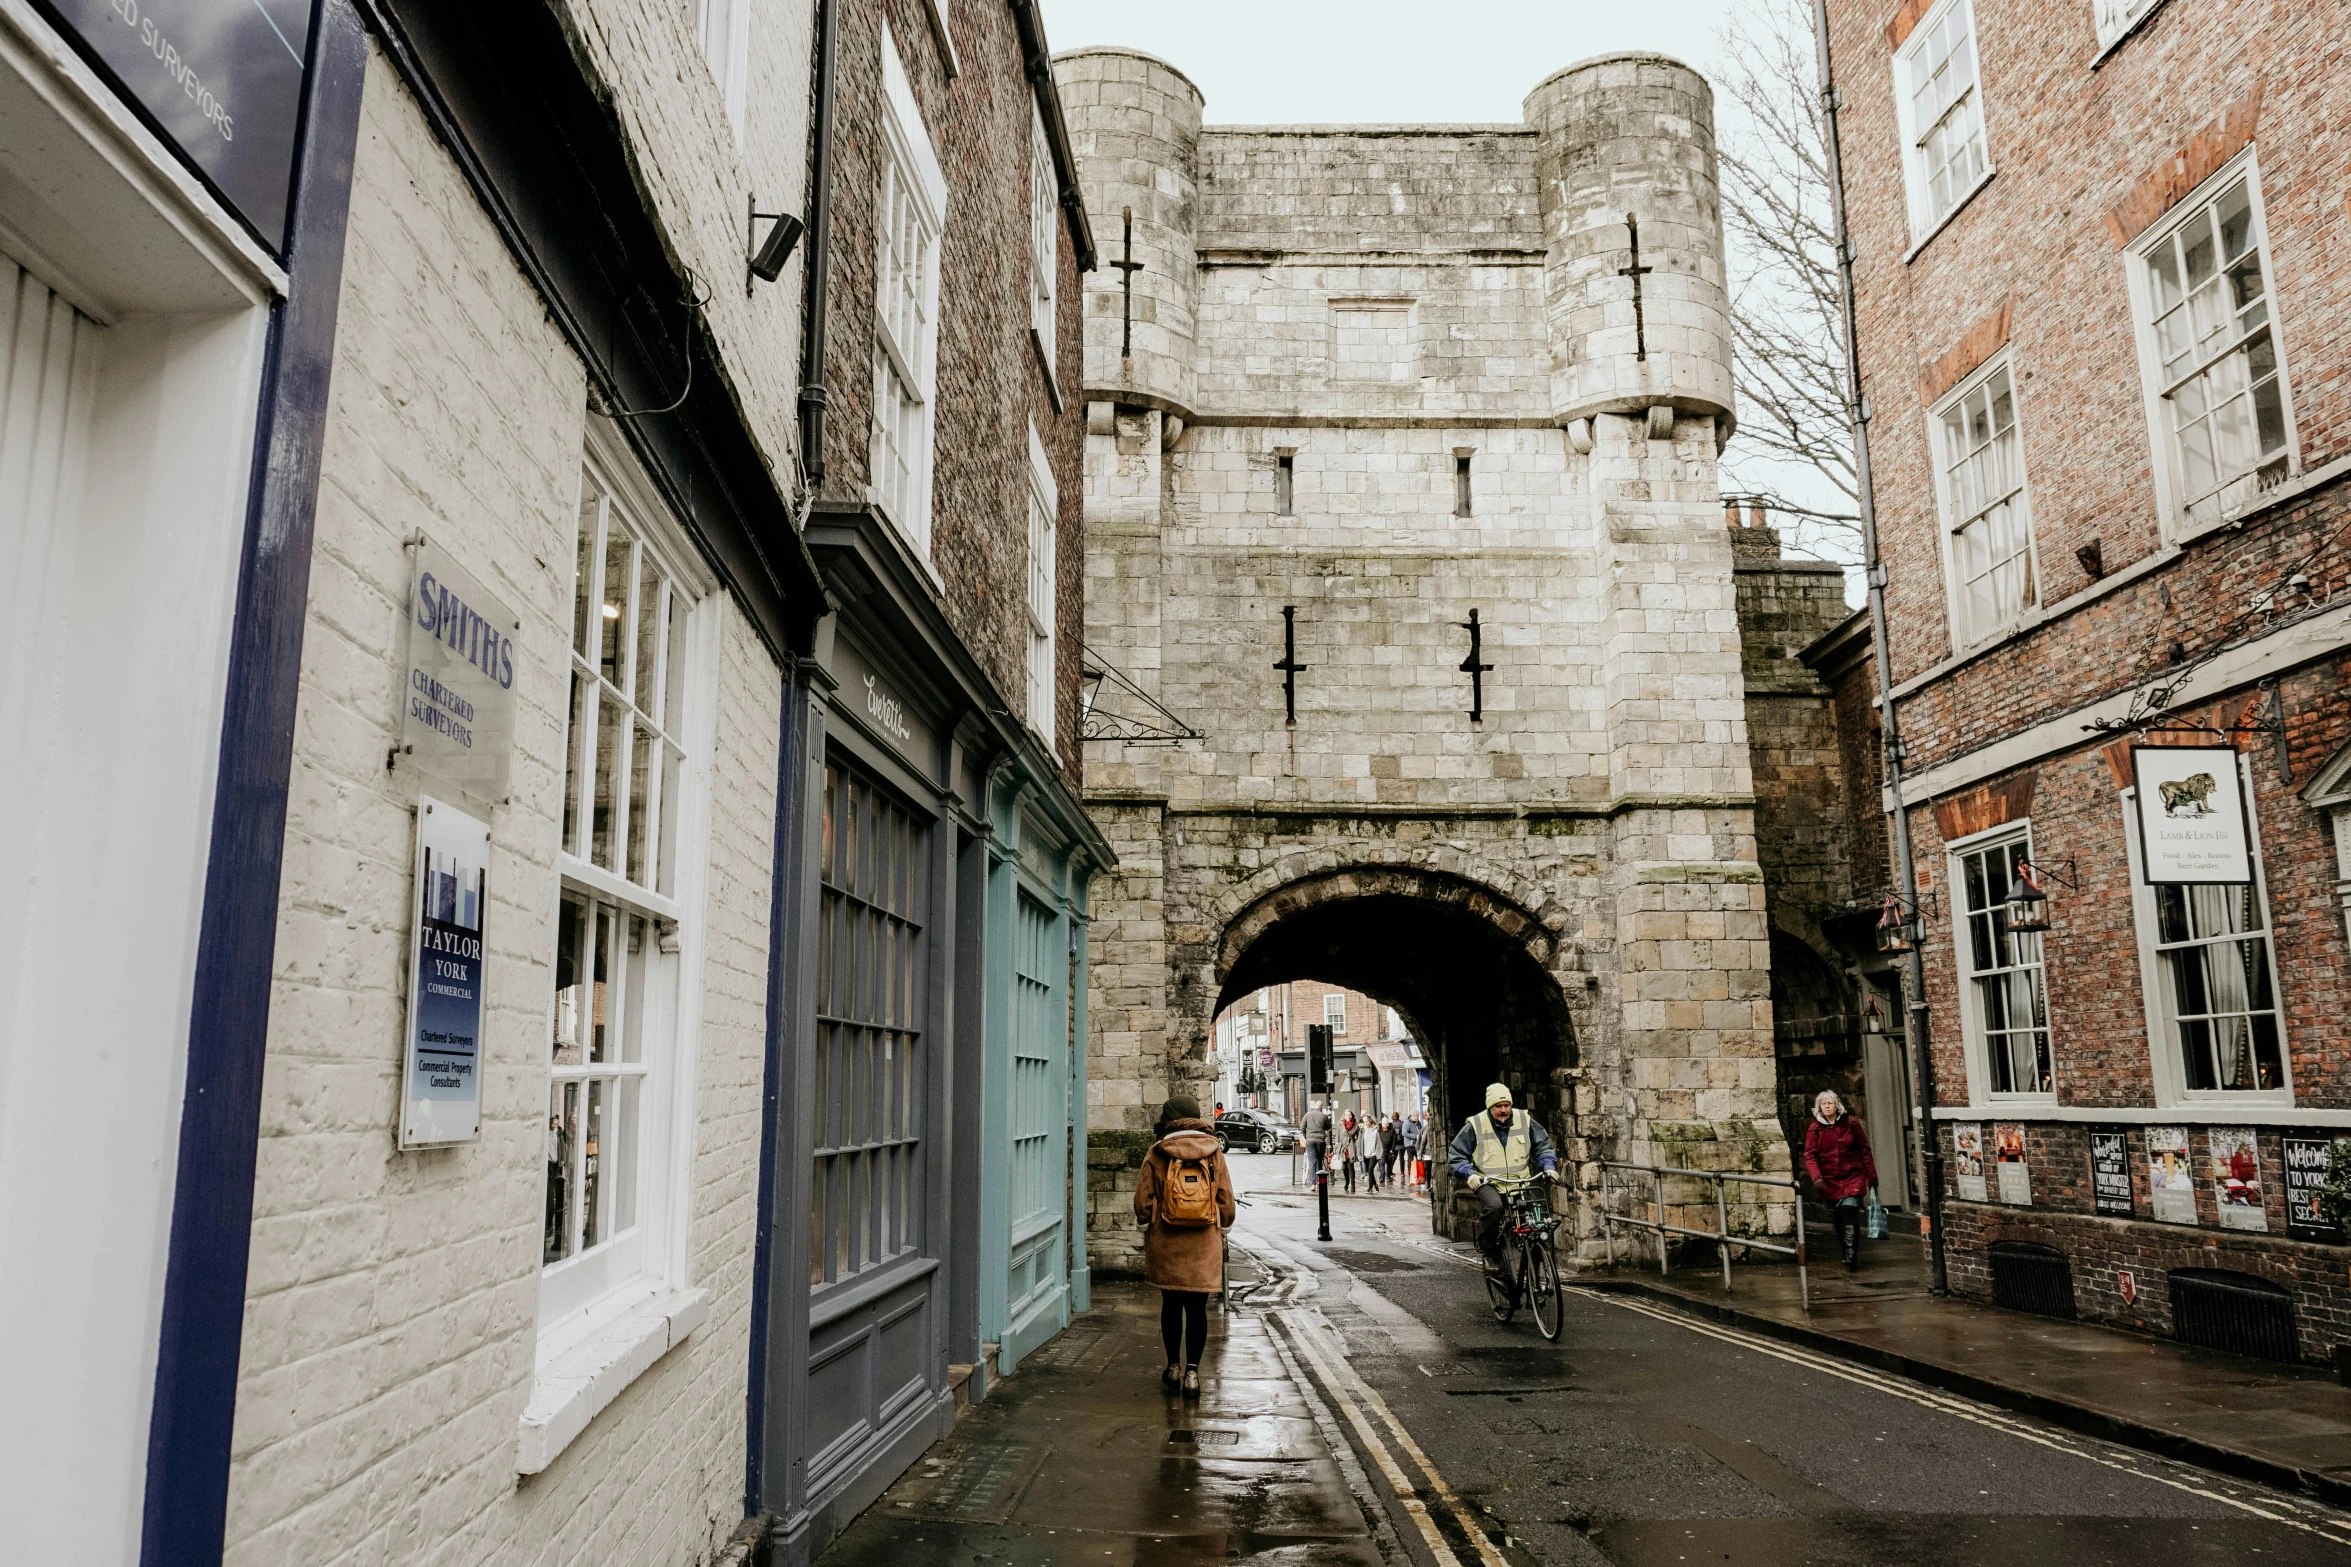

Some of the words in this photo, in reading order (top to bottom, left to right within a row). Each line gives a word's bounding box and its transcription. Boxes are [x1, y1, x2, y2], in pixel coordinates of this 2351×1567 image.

[141, 18, 234, 141] SURVEYORS
[418, 572, 513, 690] SMITHS
[413, 669, 474, 722] CHARTERED
[411, 697, 473, 748] SURVEYORS
[2160, 831, 2184, 840] LAMB
[2185, 831, 2192, 840] &
[2193, 831, 2214, 840] LION
[2215, 831, 2229, 840] INN
[422, 926, 481, 960] TAYLOR
[436, 959, 467, 981] YORK
[427, 982, 473, 1000] COMMERCIAL
[421, 1030, 447, 1044] Chartered
[449, 1033, 473, 1048] Surveyors
[419, 1060, 450, 1073] Commercial
[452, 1062, 473, 1077] Property
[430, 1075, 461, 1088] Consultants
[2290, 1171, 2302, 1186] TO
